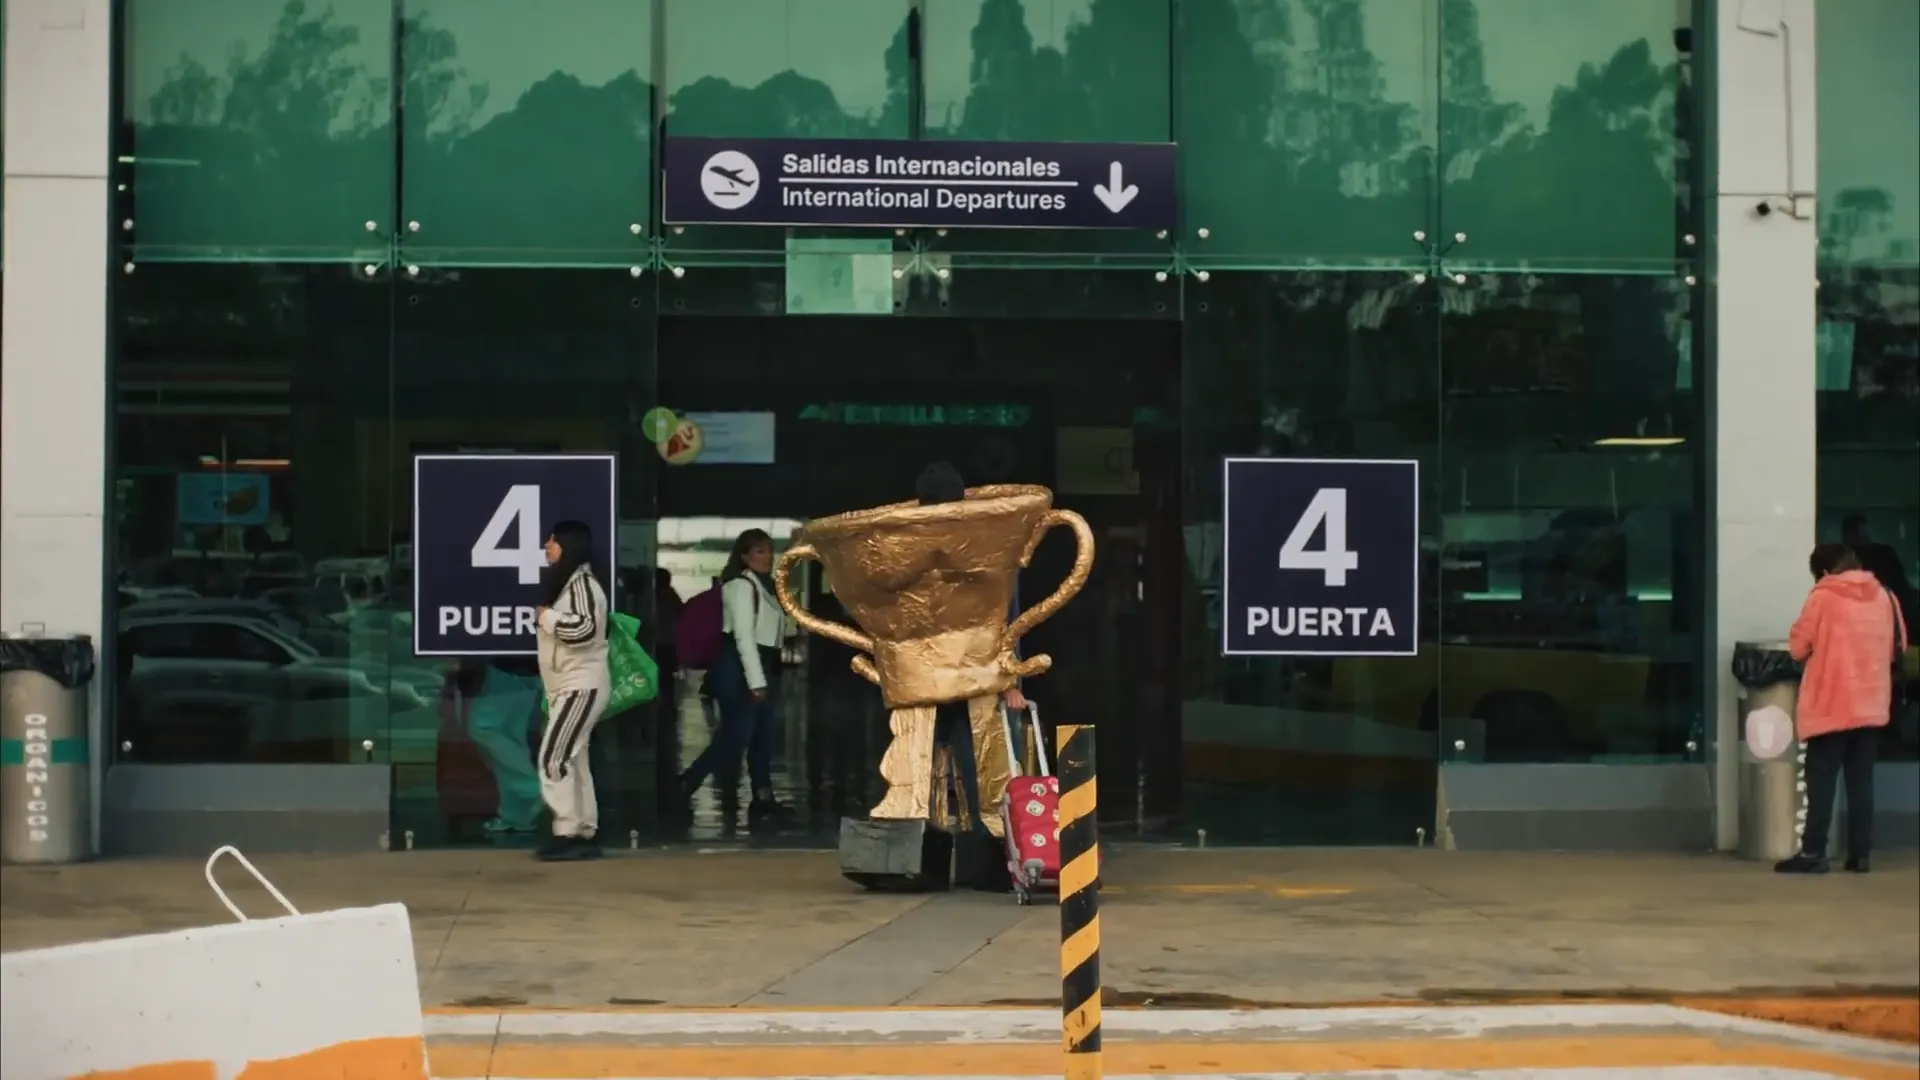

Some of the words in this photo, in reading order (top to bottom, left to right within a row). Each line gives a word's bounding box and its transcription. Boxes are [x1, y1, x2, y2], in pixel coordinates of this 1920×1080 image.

[782, 154, 870, 175] Salidas
[875, 156, 1061, 179] Internacionales
[783, 187, 929, 211] International
[936, 189, 1066, 214] Departures
[471, 485, 549, 585] 4
[1278, 487, 1359, 587] 4
[439, 605, 537, 636] PUER
[1247, 606, 1396, 637] PUERTA
